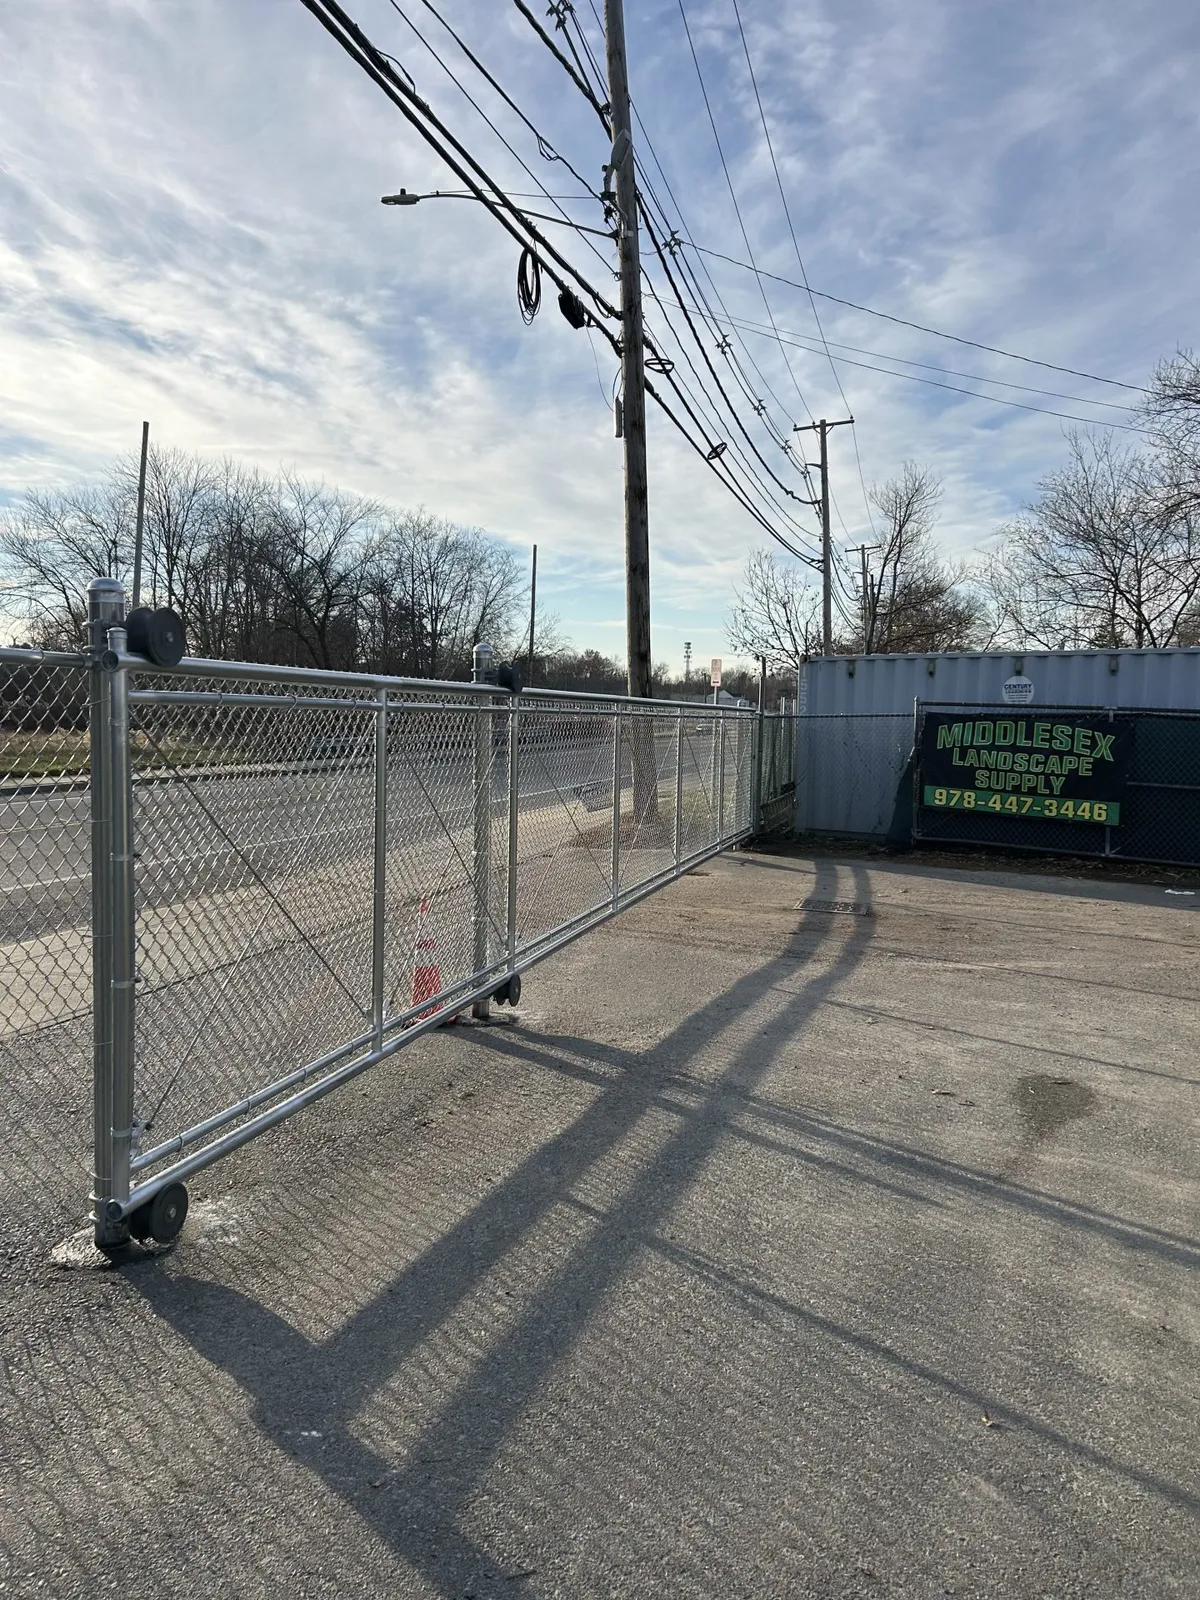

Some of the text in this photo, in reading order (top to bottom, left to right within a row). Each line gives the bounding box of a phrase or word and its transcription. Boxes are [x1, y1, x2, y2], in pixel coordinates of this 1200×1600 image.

[936, 721, 1116, 762] MIDDLESEX
[952, 747, 1094, 776] LANDSCAPE
[974, 769, 1066, 795] SUPPLY
[934, 788, 1108, 821] 978-447-3446
